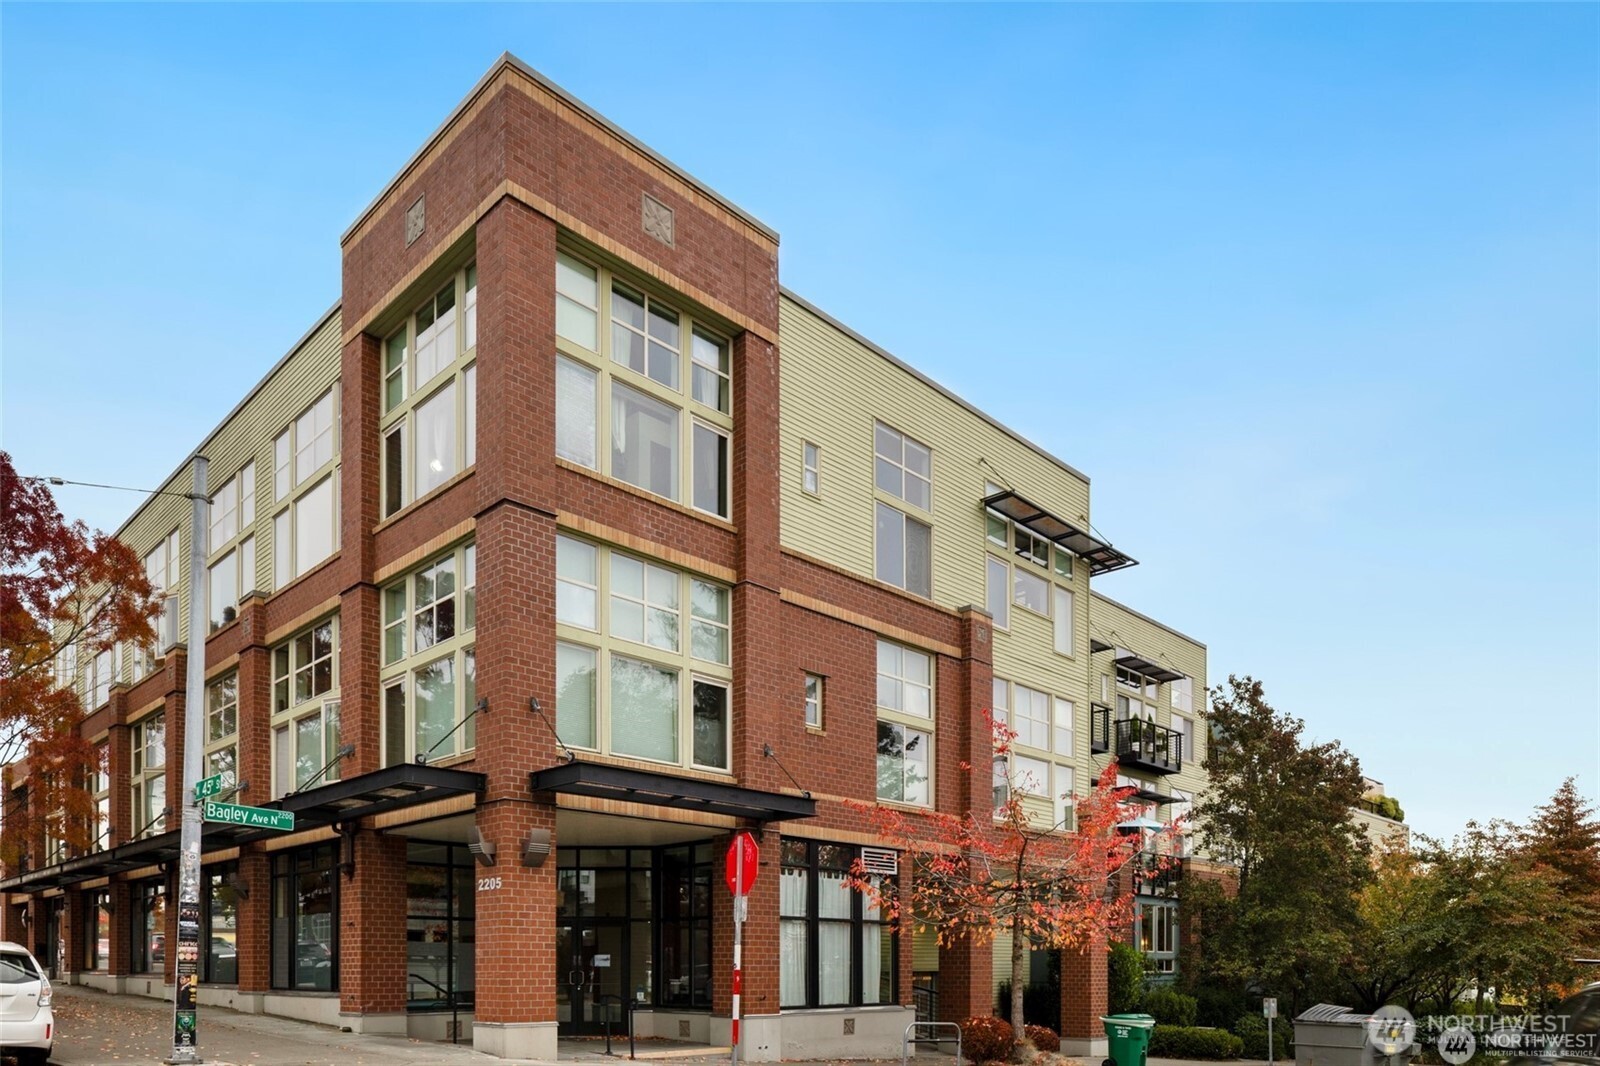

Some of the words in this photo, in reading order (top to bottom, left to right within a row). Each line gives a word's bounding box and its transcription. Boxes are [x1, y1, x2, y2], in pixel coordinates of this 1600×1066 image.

[207, 803, 249, 824] Bagley
[251, 813, 269, 824] Ave
[270, 816, 278, 825] N
[478, 877, 502, 891] 2205
